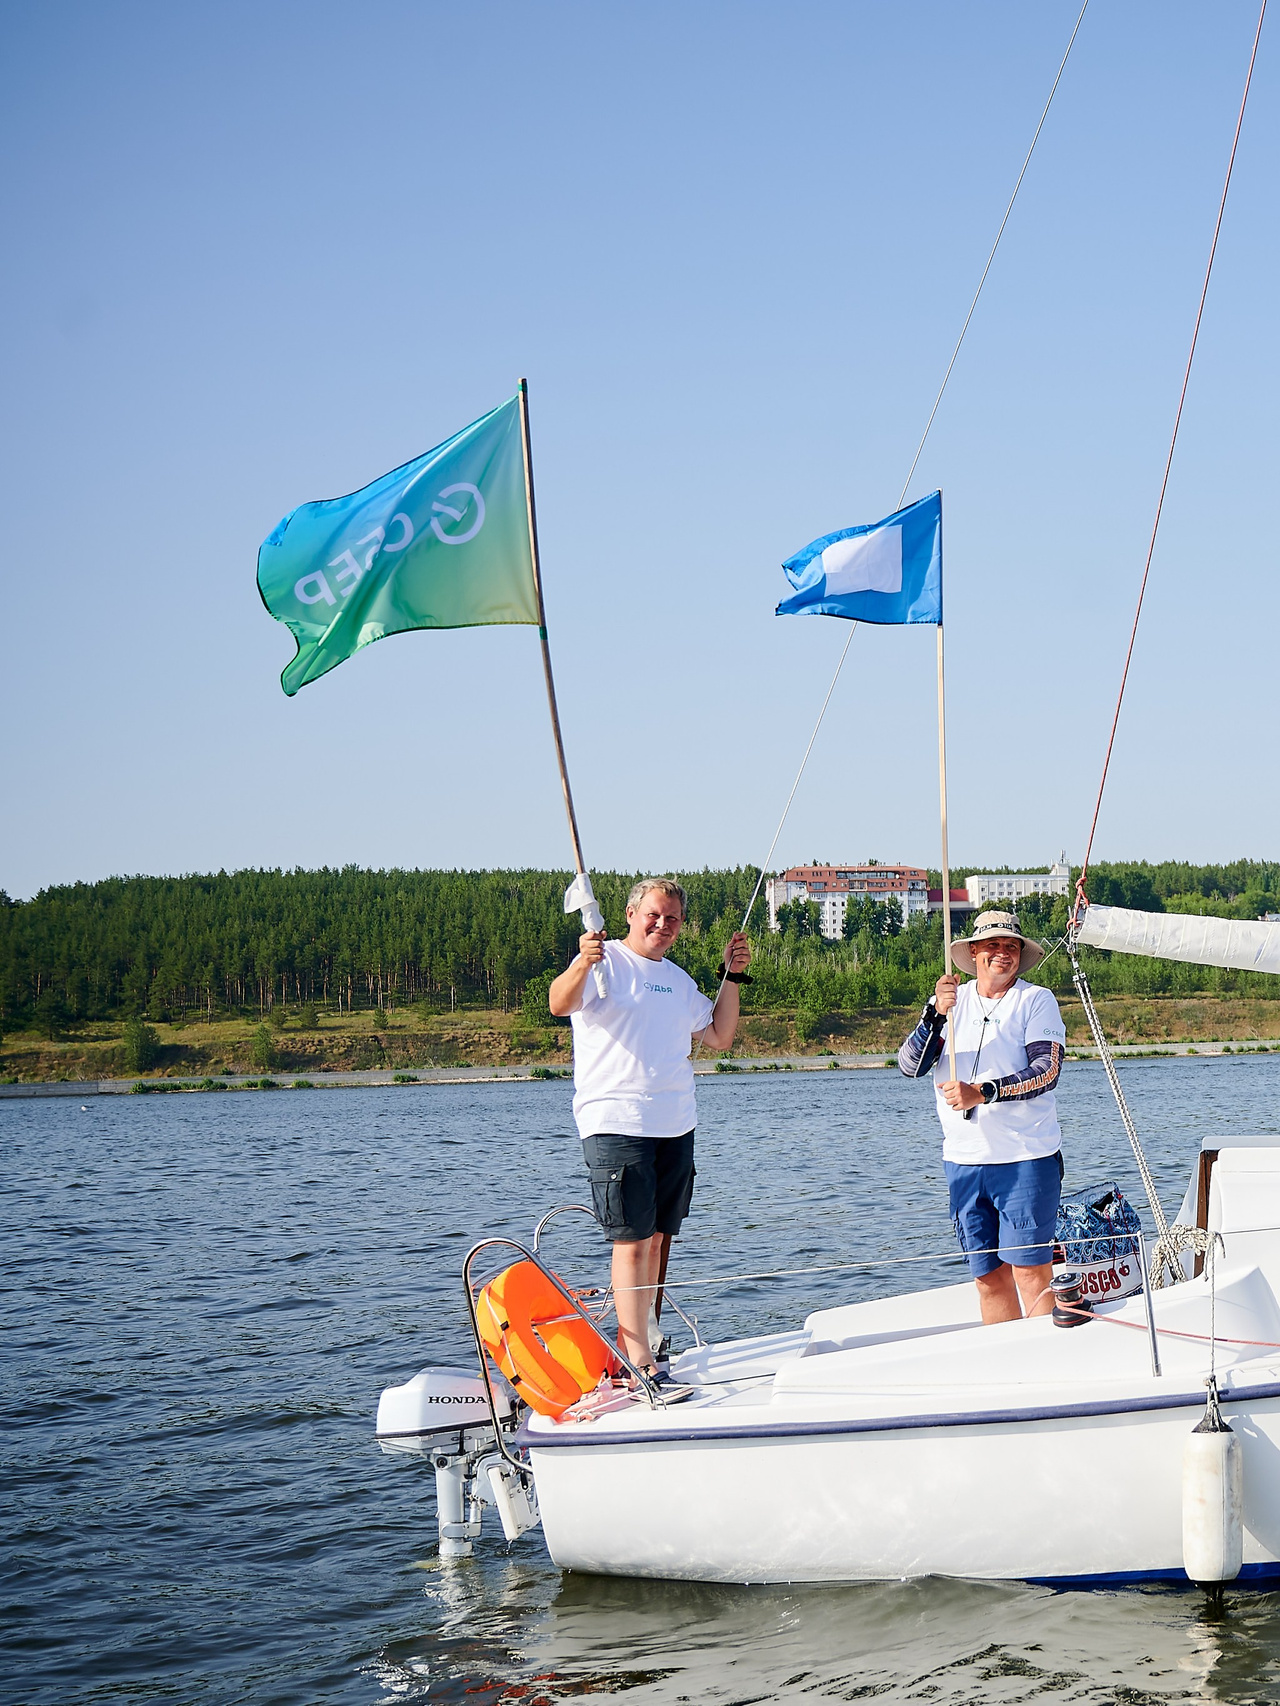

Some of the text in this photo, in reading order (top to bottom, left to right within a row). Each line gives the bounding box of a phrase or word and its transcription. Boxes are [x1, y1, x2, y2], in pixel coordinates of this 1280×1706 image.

[643, 981, 673, 994] судья
[1080, 1267, 1122, 1295] OSCO
[428, 1396, 487, 1404] HONDA
